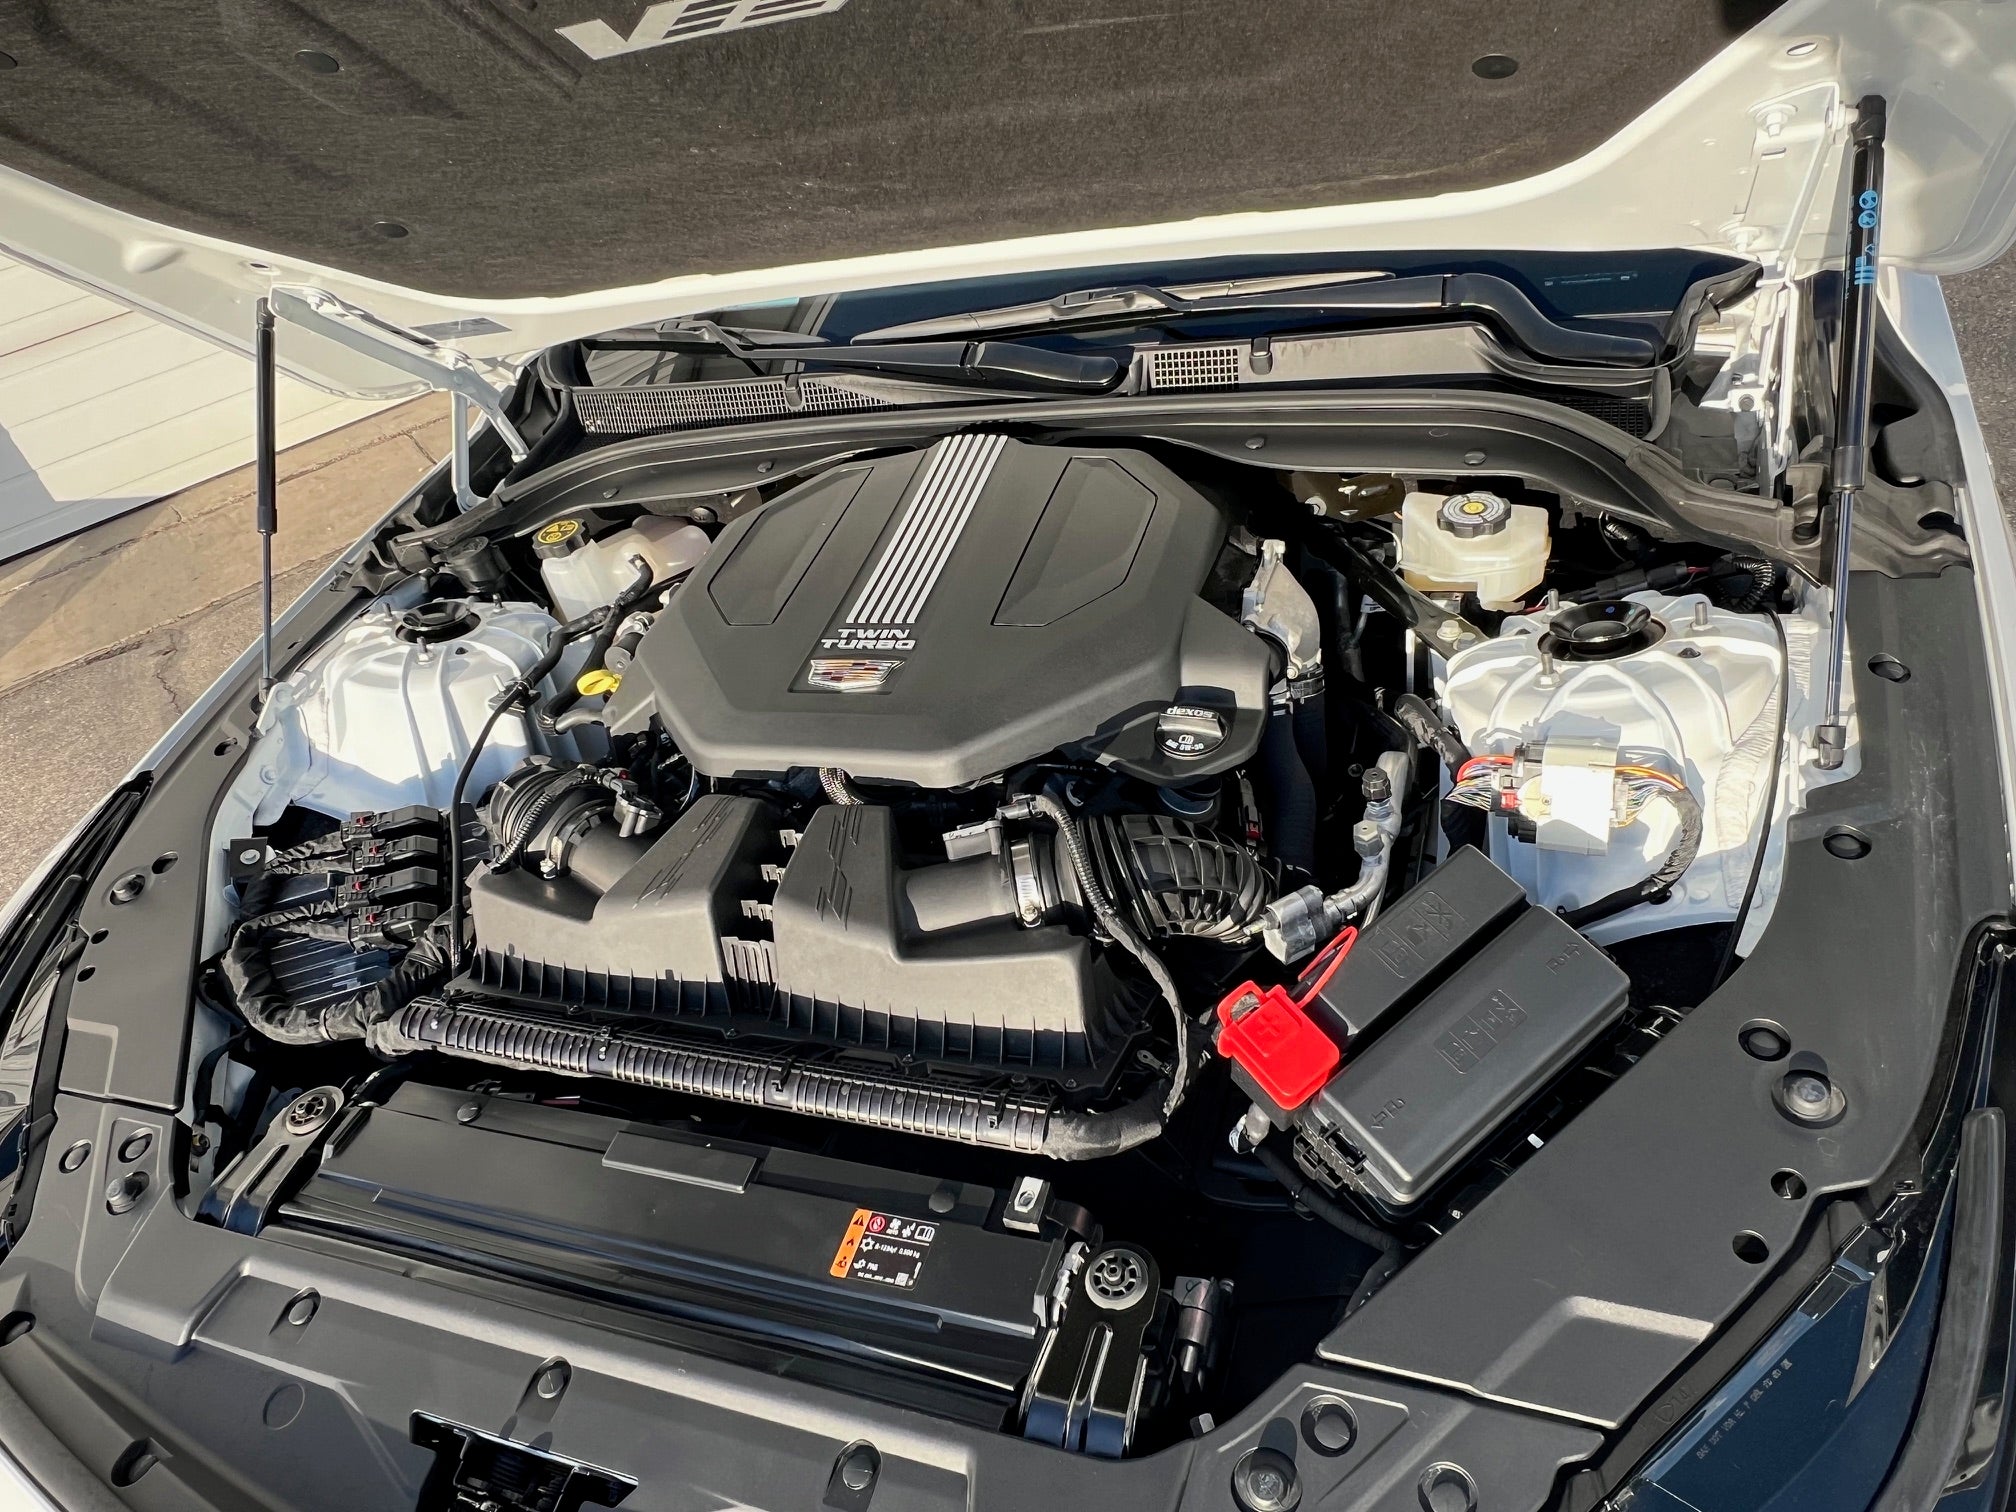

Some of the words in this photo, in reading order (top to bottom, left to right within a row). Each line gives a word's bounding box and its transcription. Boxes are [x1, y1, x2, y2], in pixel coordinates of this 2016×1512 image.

[837, 628, 910, 639] TWIN
[821, 638, 916, 650] TURBO
[1166, 706, 1215, 719] dexos
